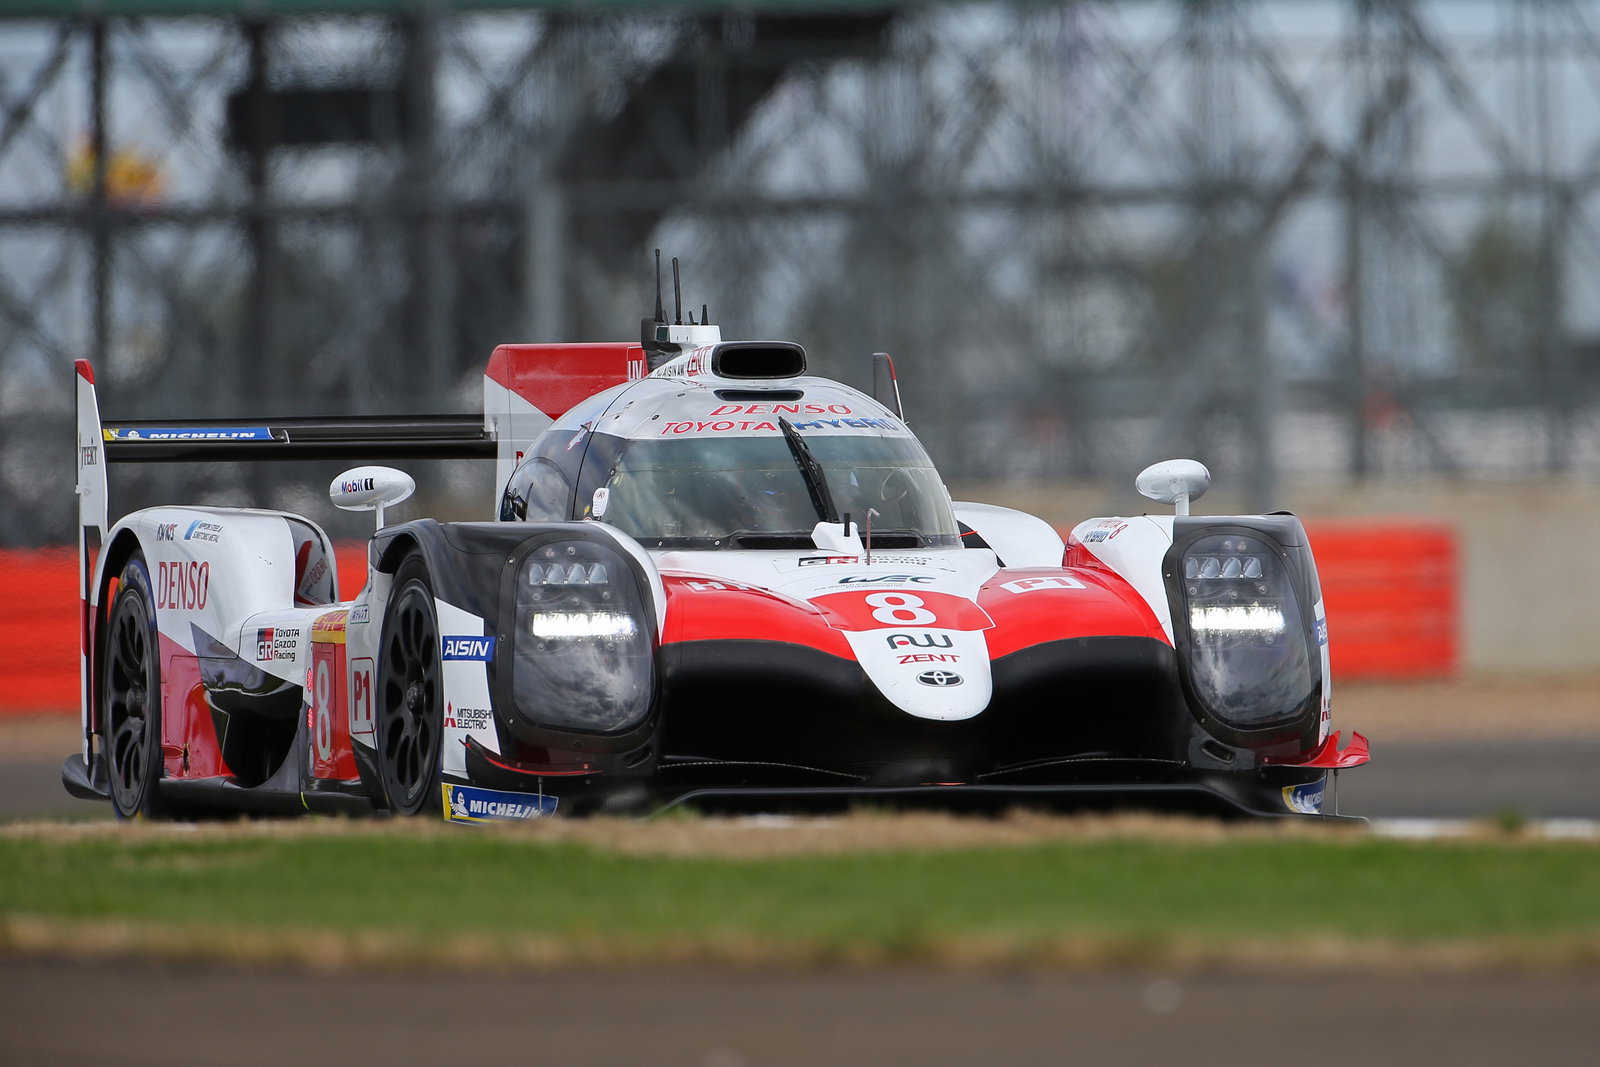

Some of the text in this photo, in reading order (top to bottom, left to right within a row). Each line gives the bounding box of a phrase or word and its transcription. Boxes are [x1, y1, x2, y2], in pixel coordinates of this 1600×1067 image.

[709, 404, 853, 416] DENSO
[661, 418, 900, 435] TOYOTA HYBRID
[341, 477, 375, 494] Mobil 1
[1109, 525, 1128, 539] 8
[157, 561, 209, 610] DENSO
[838, 575, 936, 584] WEC
[1013, 578, 1072, 590] P1
[865, 592, 937, 626] 8
[257, 628, 300, 661] GR TOYOTA
[274, 639, 296, 649] GAZOO
[444, 640, 490, 657] AISIN
[274, 650, 296, 662] Racing
[896, 654, 960, 665] ZENT
[353, 670, 371, 721] P1
[316, 659, 331, 761] 8
[457, 708, 492, 719] MITSUBISHI
[457, 719, 487, 730] ELECTRIC
[470, 800, 544, 819] MICHELIN
